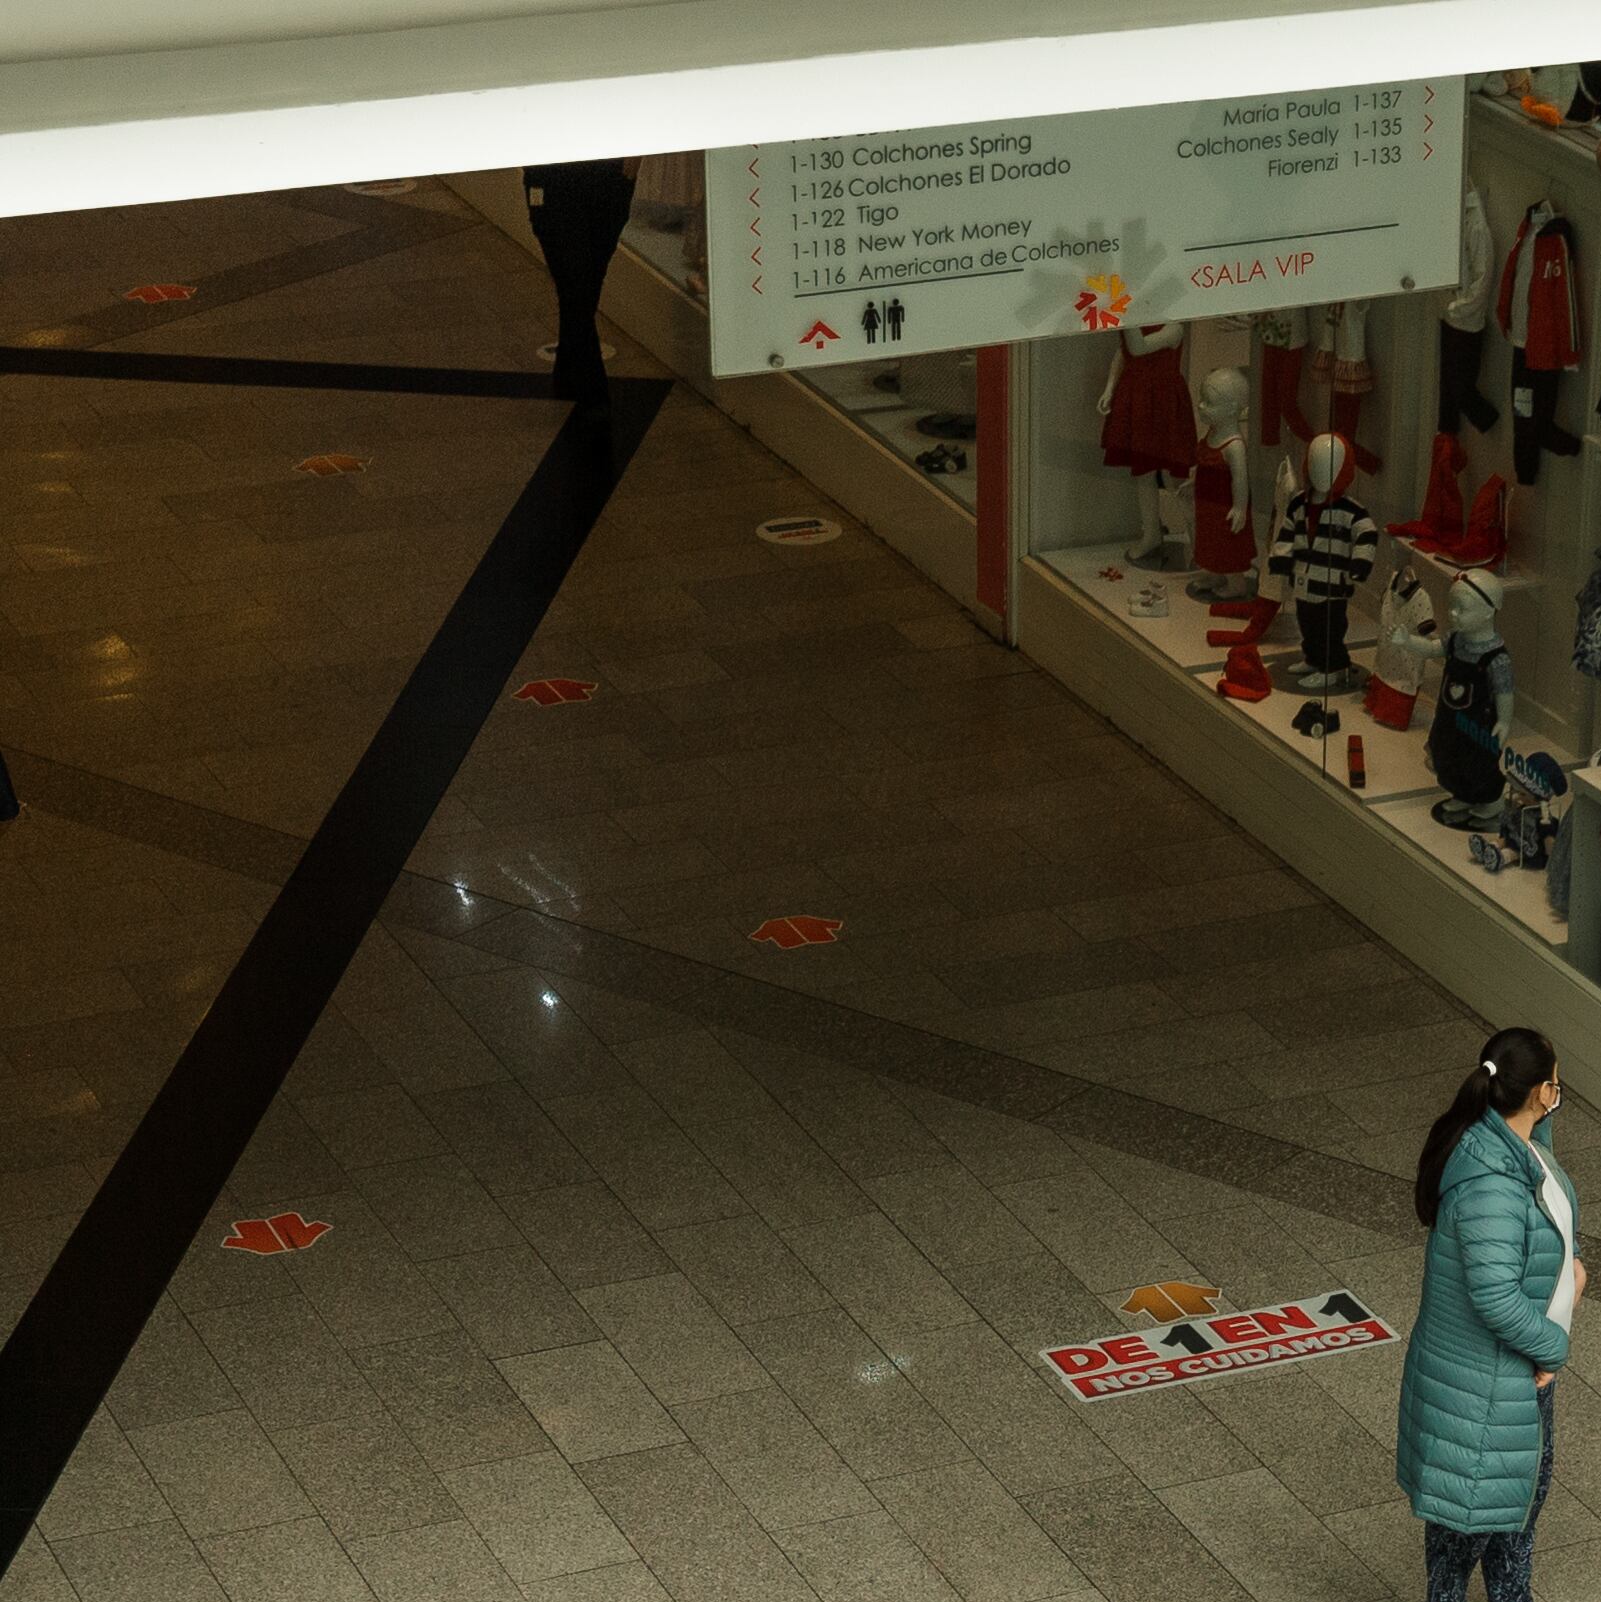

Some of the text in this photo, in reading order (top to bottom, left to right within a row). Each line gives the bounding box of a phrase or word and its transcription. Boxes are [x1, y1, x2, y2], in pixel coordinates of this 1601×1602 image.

[1286, 98, 1341, 120] Paula
[1352, 90, 1402, 113] 1-137
[791, 133, 1032, 173] 1-130 Colchones Spring
[1177, 117, 1402, 159] Colchones Sealy 1-135
[791, 156, 1071, 203] 1-126 Colchones El Dorado
[1267, 145, 1402, 177] Fiorenzi 1-133
[791, 204, 899, 231] 1-122 Tigo
[793, 219, 1032, 260] 1-118 New York Money
[793, 236, 1120, 289] 1-116 Americana de Colchones
[1201, 251, 1314, 288] SALA VIP
[1046, 1291, 1372, 1375] DE 1 EN 1
[1090, 1327, 1376, 1394] NOS CUIDAMOS
